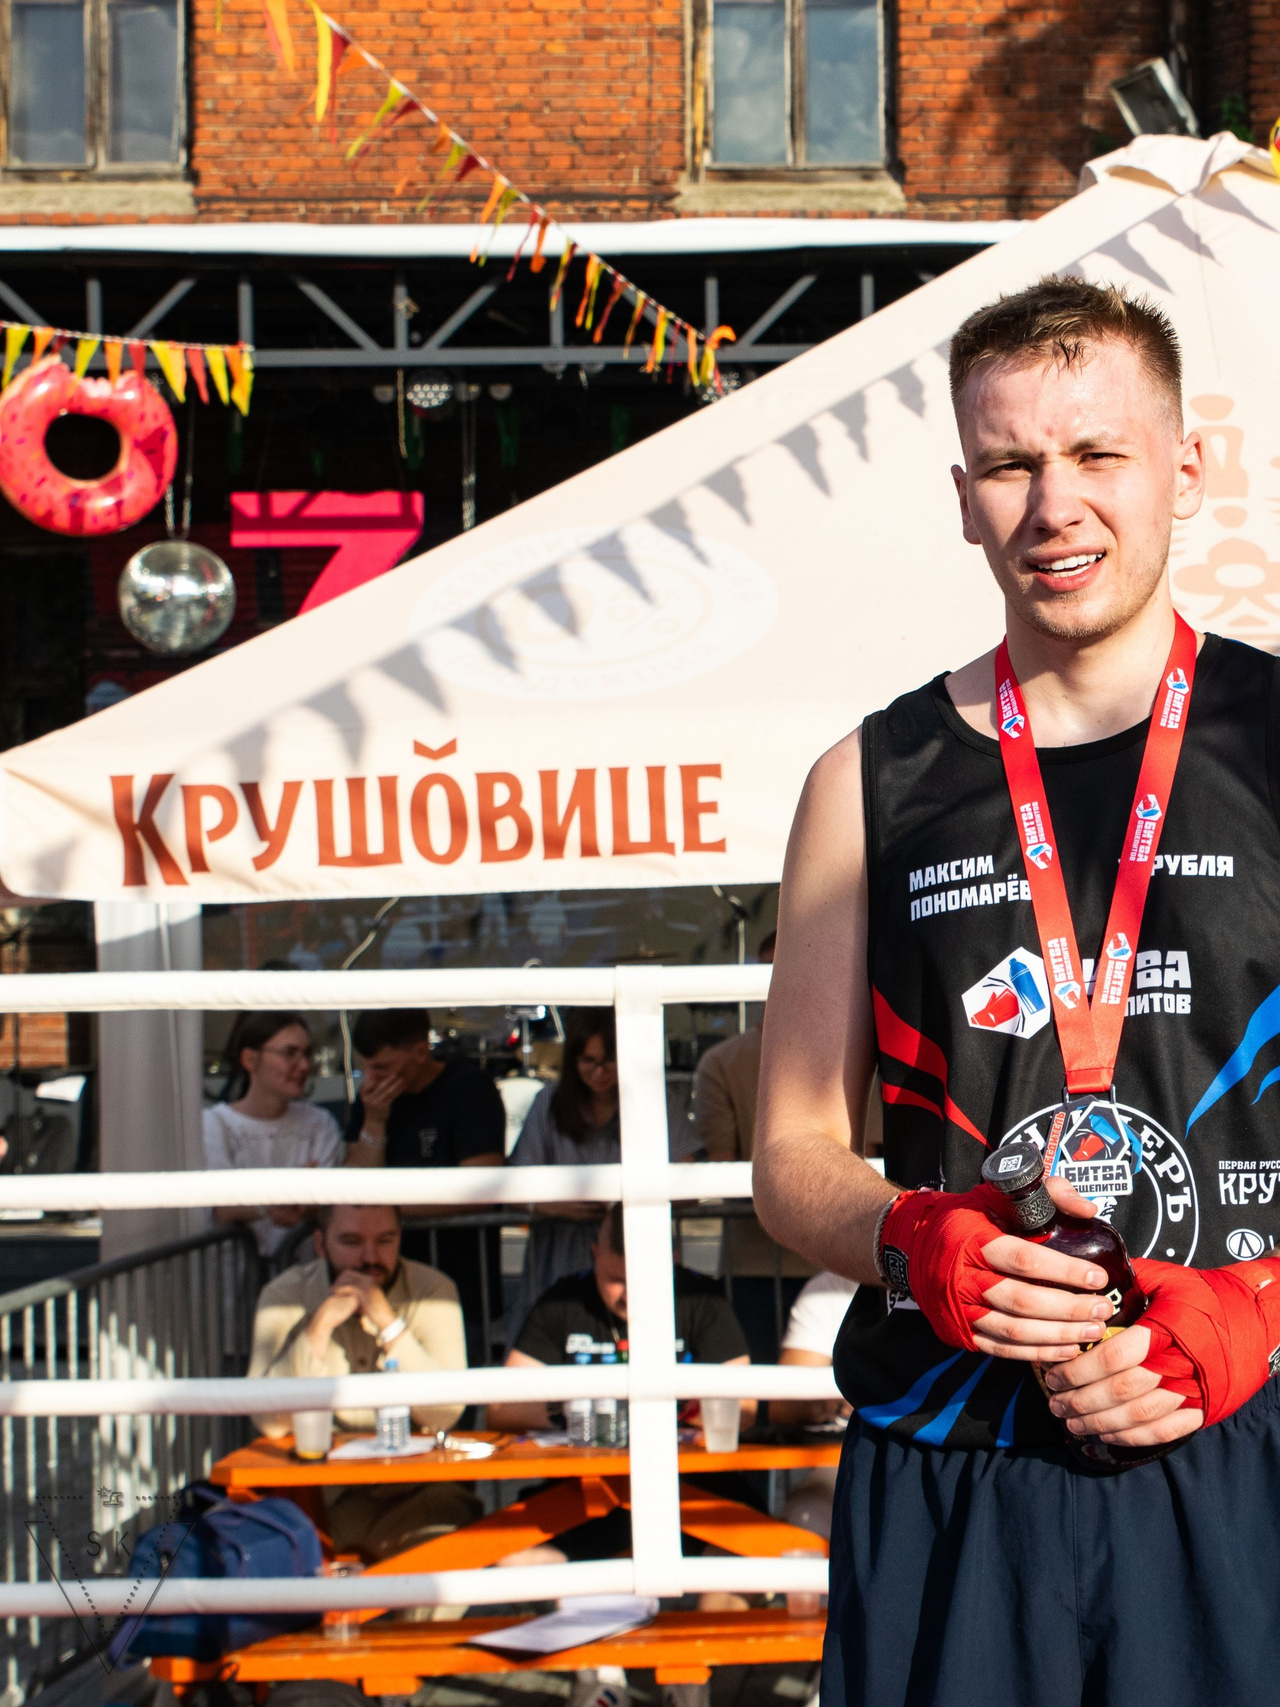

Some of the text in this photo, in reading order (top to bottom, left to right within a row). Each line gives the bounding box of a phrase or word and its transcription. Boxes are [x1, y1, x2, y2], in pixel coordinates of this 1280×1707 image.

[1167, 692, 1185, 729] БИТВА
[1020, 802, 1039, 844] БИТВА
[1136, 821, 1156, 862] БИТВА
[909, 854, 994, 893] МАКСИМ
[910, 873, 1032, 922] ПОНОМАРЁВ
[1047, 938, 1067, 982] БИТВА
[1108, 960, 1127, 1004] БИТВА
[1124, 992, 1192, 1017] ПИТОВ
[1064, 1164, 1128, 1183] БИТВА
[1218, 1160, 1257, 1170] ПЕРВАЯ
[1073, 1182, 1128, 1193] БЩЕПИТОВ
